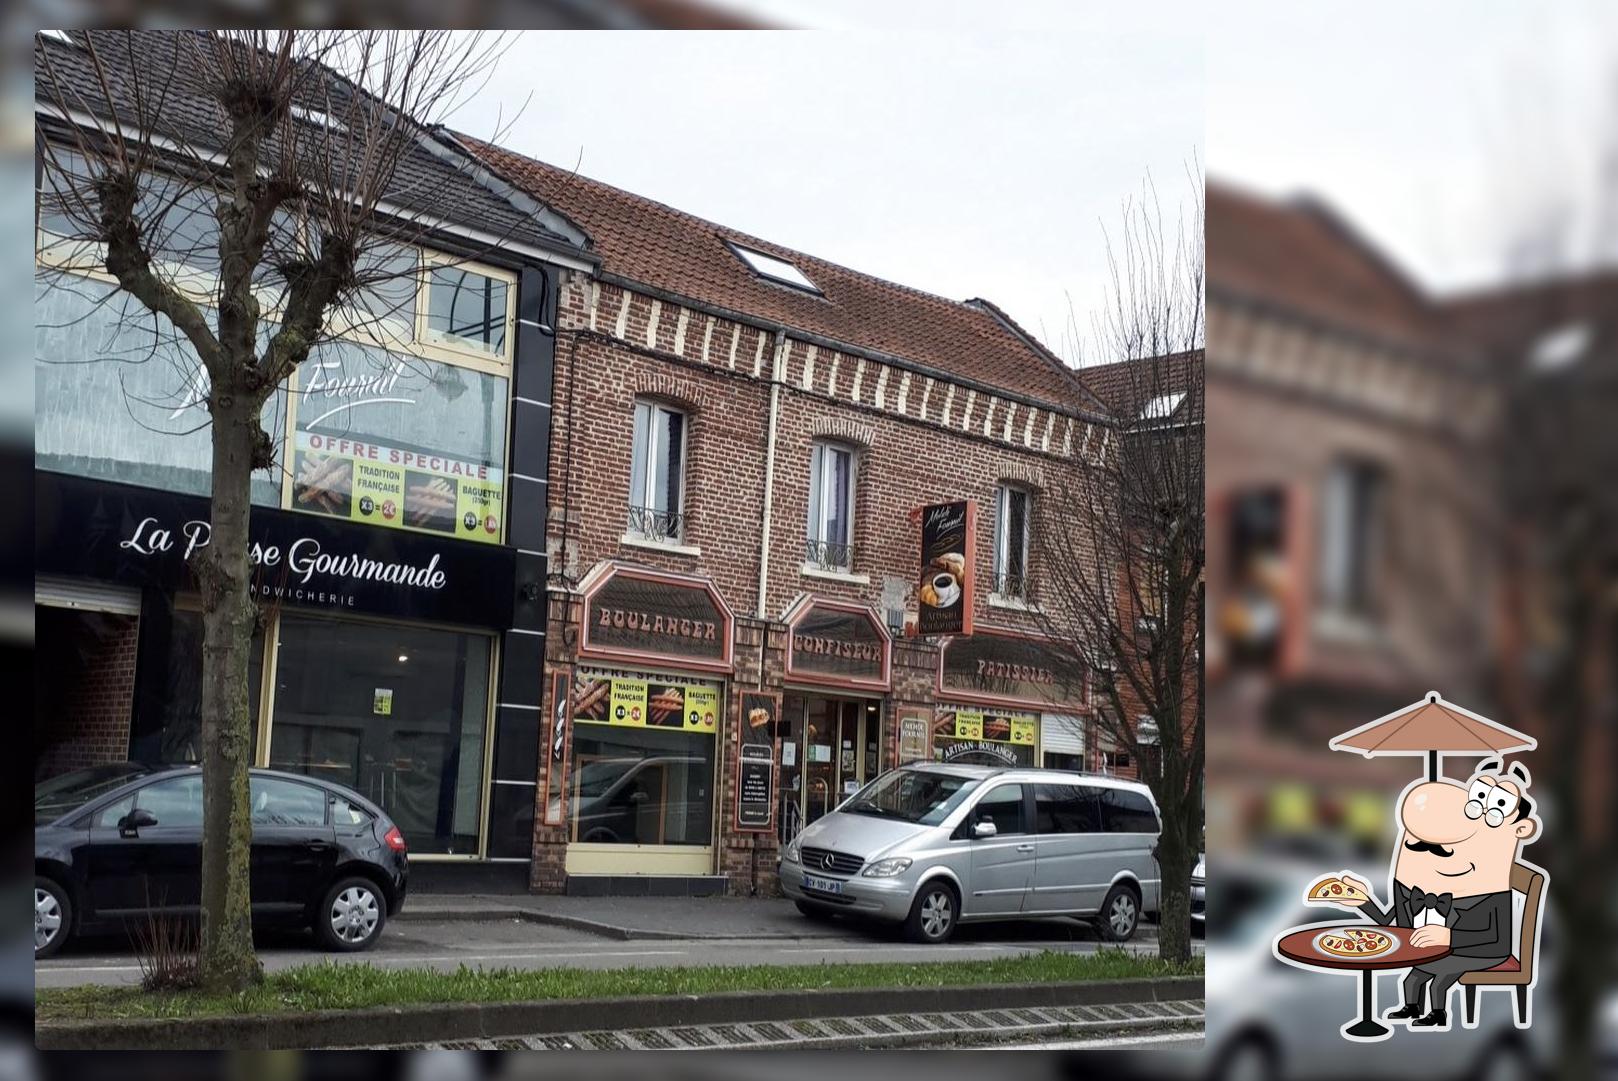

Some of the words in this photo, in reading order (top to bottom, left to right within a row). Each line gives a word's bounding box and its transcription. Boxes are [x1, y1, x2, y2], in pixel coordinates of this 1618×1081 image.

[302, 355, 407, 404] Fournil
[308, 434, 379, 460] OFFRE
[389, 449, 489, 480] SPECIALE
[358, 465, 401, 481] TRADITION
[357, 478, 401, 494] FRANÇAISE
[462, 485, 501, 500] BAGUETTE
[119, 516, 174, 555] La
[183, 520, 282, 567] Pse
[288, 537, 447, 590] Gourmande
[250, 583, 356, 607] NDWICHERIE
[600, 607, 716, 641] BOULANGER
[793, 634, 882, 662] CONFISEUR
[581, 665, 630, 679] OFFRE
[636, 671, 708, 687] SPECIALE
[977, 659, 1054, 686] PATISSIER
[614, 692, 644, 702] FRANÇAISE
[615, 682, 645, 692] TRADITION
[944, 741, 975, 760] ARTISAN
[978, 741, 1018, 765] BOULANGER
